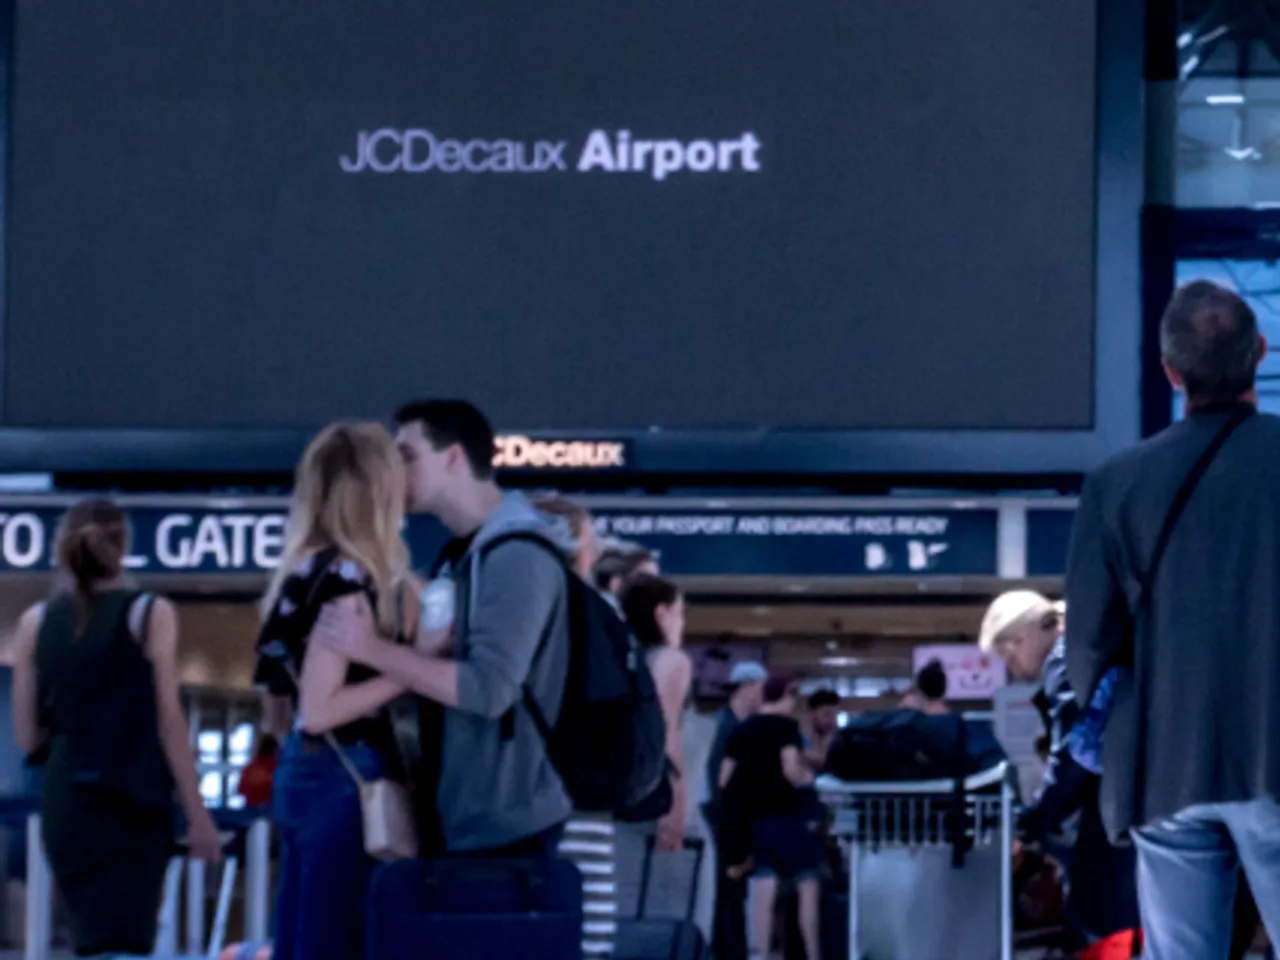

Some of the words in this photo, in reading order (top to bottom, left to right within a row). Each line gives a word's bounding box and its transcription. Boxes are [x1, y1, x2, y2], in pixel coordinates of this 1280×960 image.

[339, 129, 568, 173] JCDecaux
[577, 130, 760, 180] Airport
[612, 515, 652, 535] YOUR
[656, 515, 735, 535] PASSPORT
[737, 515, 769, 535] AND
[773, 515, 851, 535] BOARDING
[854, 515, 893, 535] PASS
[895, 515, 949, 535] READY
